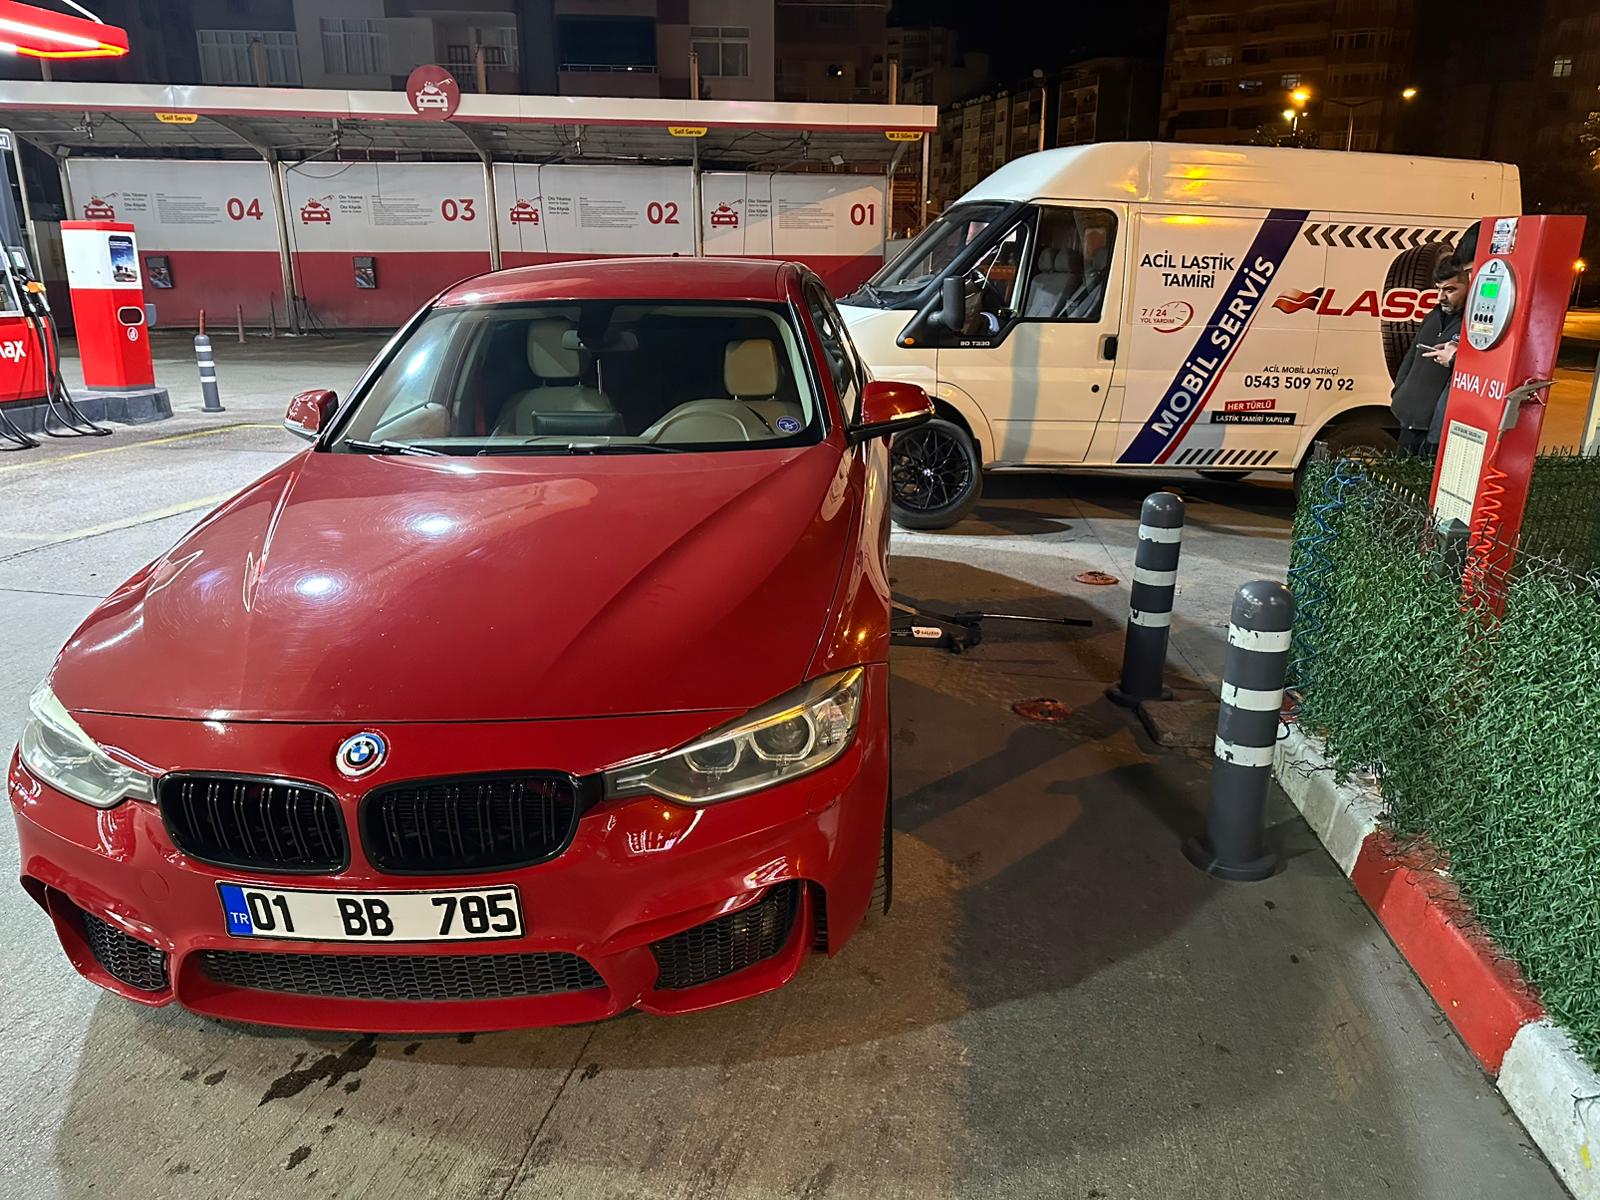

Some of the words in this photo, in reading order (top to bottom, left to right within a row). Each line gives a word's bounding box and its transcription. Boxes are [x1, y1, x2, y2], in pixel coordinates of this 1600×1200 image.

[227, 198, 264, 220] 04
[441, 199, 475, 221] 03
[647, 201, 680, 225] 02
[850, 203, 875, 226] 01
[1140, 250, 1177, 268] ACİL
[1181, 252, 1235, 270] LASTİK
[1162, 270, 1215, 288] TAMİRİ
[1142, 308, 1148, 316] 7
[1156, 309, 1167, 317] 24
[1316, 288, 1440, 319] LASS
[1151, 356, 1219, 437] MOBİL
[1211, 256, 1275, 350] SERVİS
[1263, 364, 1280, 373] ACİL
[1244, 375, 1280, 388] 0543
[1284, 376, 1311, 390] 509
[1316, 378, 1333, 390] 70
[1337, 378, 1354, 391] 92
[1452, 370, 1480, 395] HAVA
[1488, 380, 1504, 400] SU
[1227, 402, 1244, 411] HER
[1246, 400, 1272, 410] TÜRLÜ
[1216, 414, 1239, 422] LASTİK
[230, 912, 248, 924] TR
[246, 892, 295, 932] 01
[337, 898, 394, 936] BB
[431, 893, 517, 935] 785
